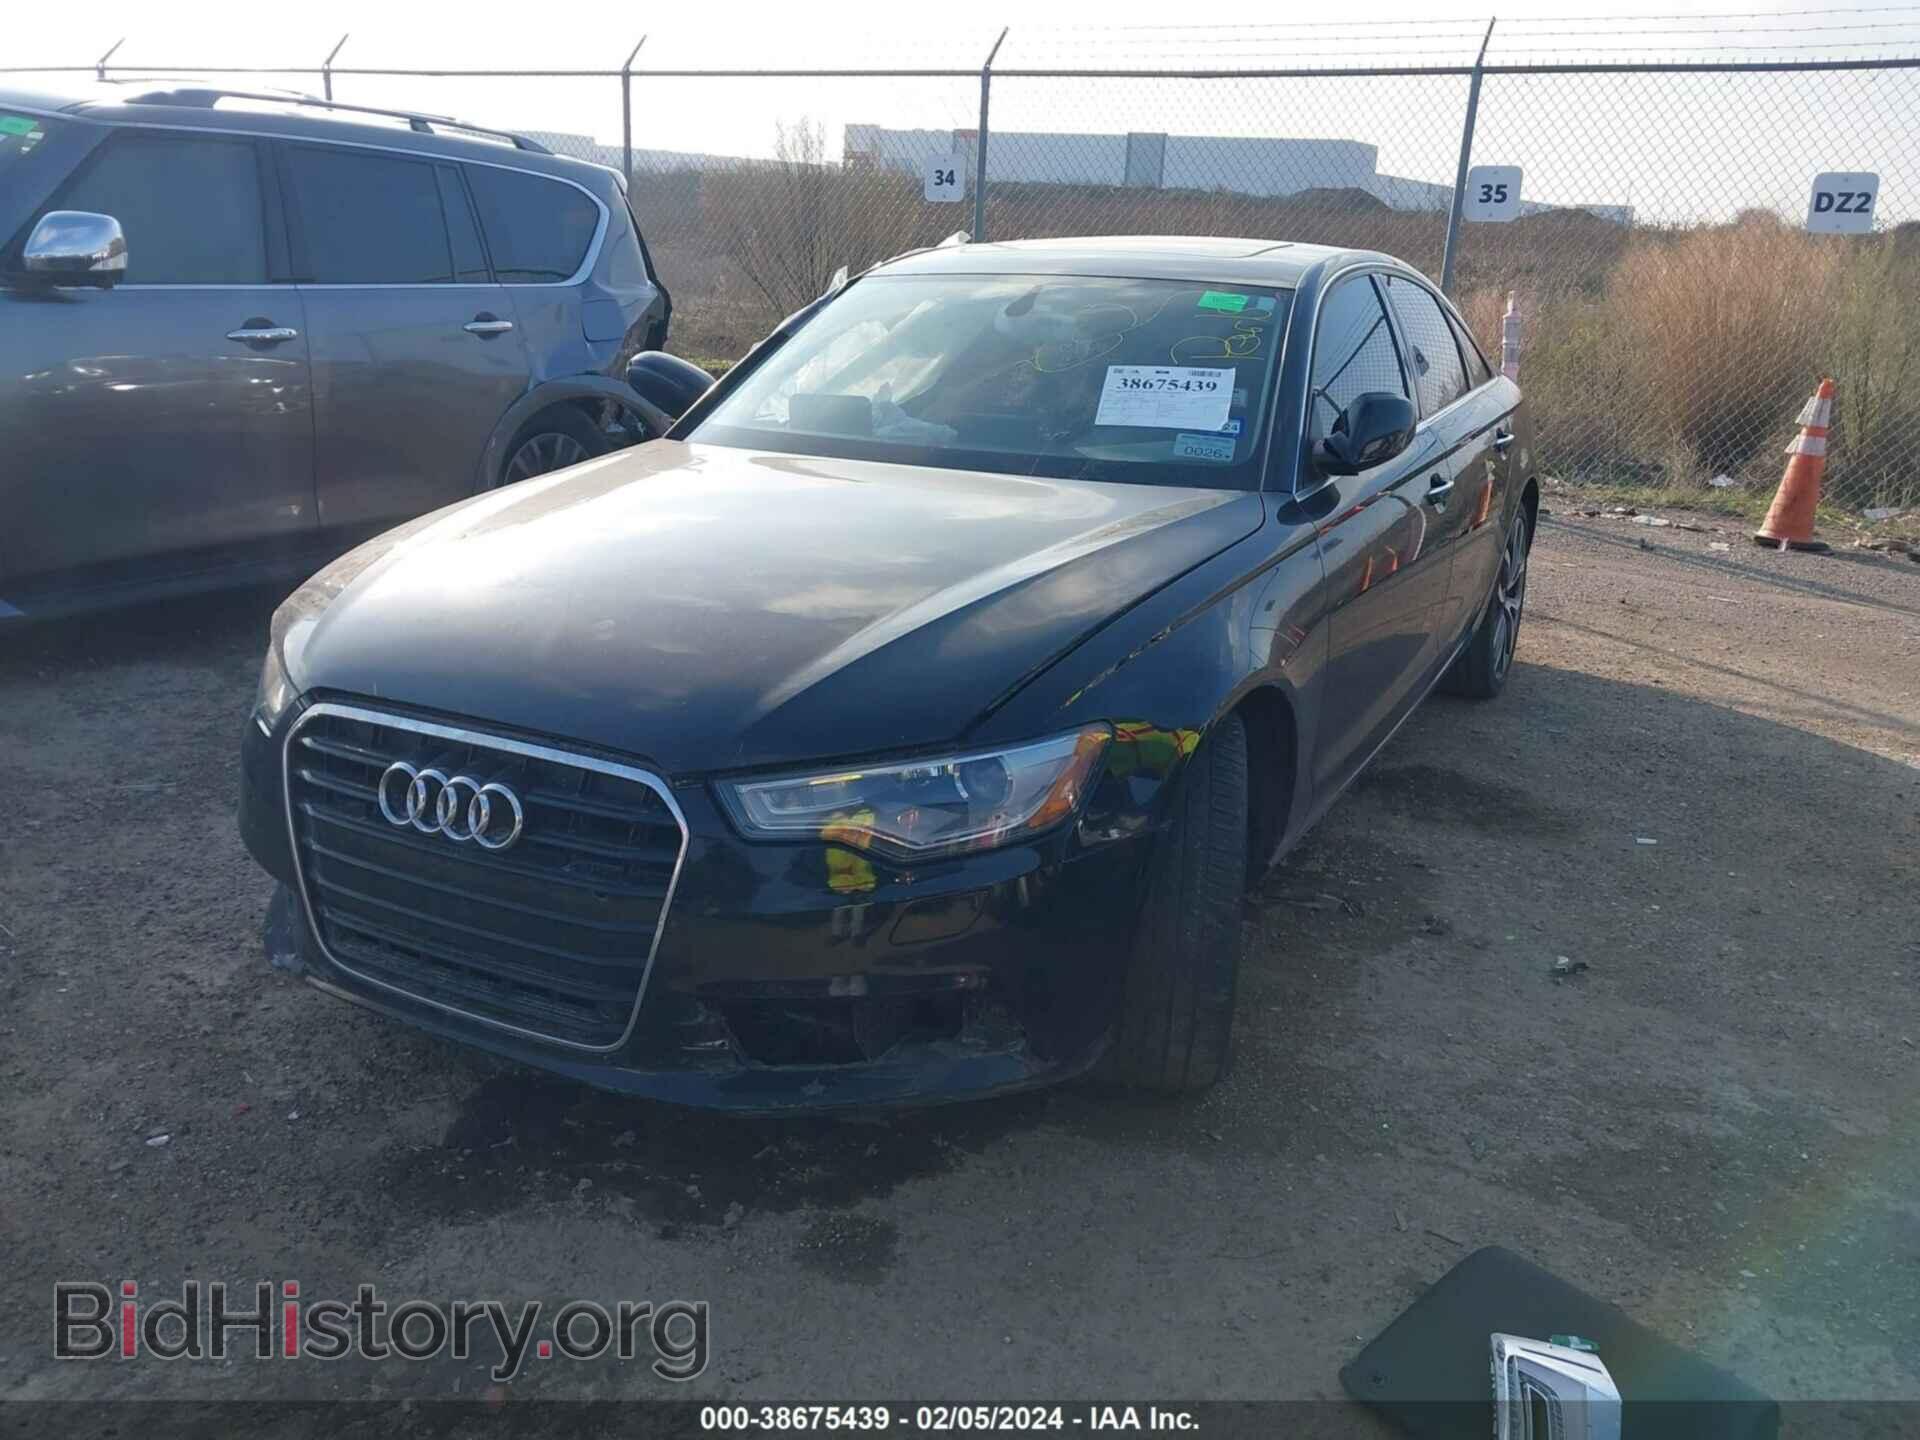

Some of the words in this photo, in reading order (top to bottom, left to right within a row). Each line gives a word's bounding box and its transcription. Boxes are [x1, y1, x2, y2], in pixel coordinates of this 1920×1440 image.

[934, 169, 956, 187] 34
[1478, 183, 1508, 204] 35
[1813, 191, 1872, 214] DZ2
[1116, 378, 1217, 392] 38675439
